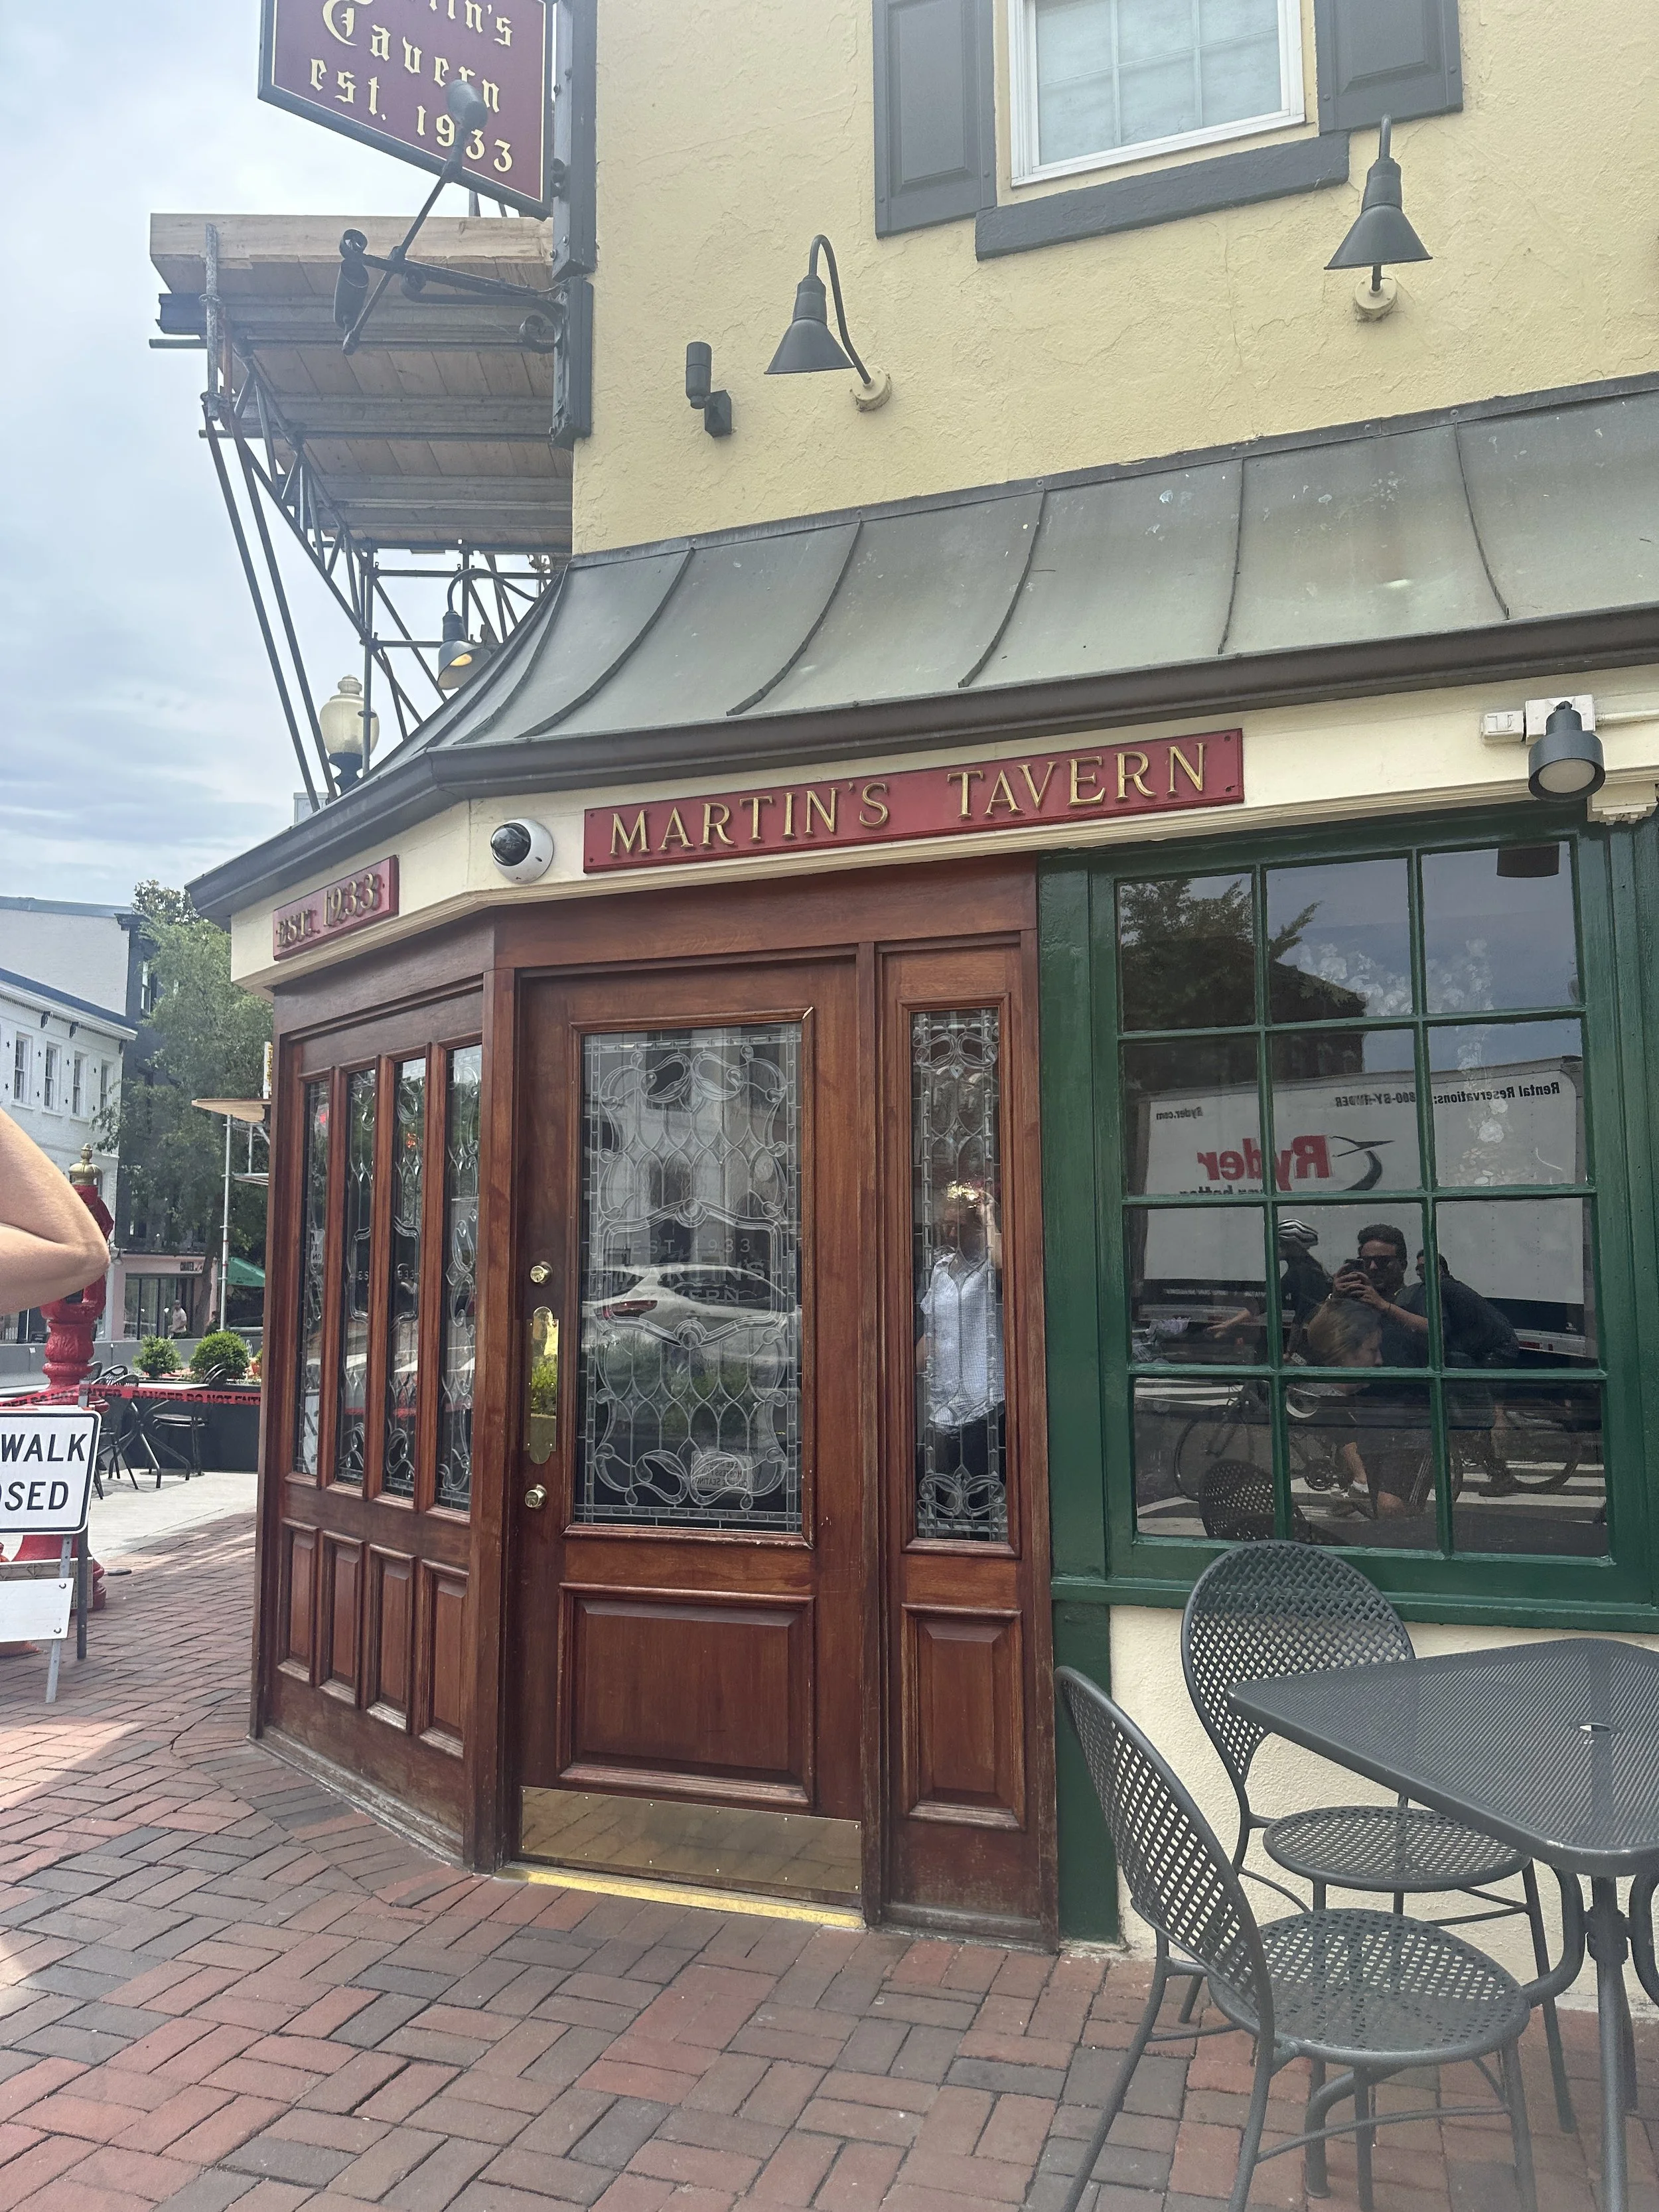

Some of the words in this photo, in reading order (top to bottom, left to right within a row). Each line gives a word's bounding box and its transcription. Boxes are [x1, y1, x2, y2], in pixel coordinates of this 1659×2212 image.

[310, 58, 387, 121] est.
[417, 105, 513, 173] 1933
[610, 782, 889, 856] MARTIN'S
[947, 742, 1205, 819] TAVERN
[276, 908, 313, 948] EST.
[323, 873, 374, 927] 1933
[1, 1434, 88, 1462] WALK
[0, 1481, 69, 1511] SED
